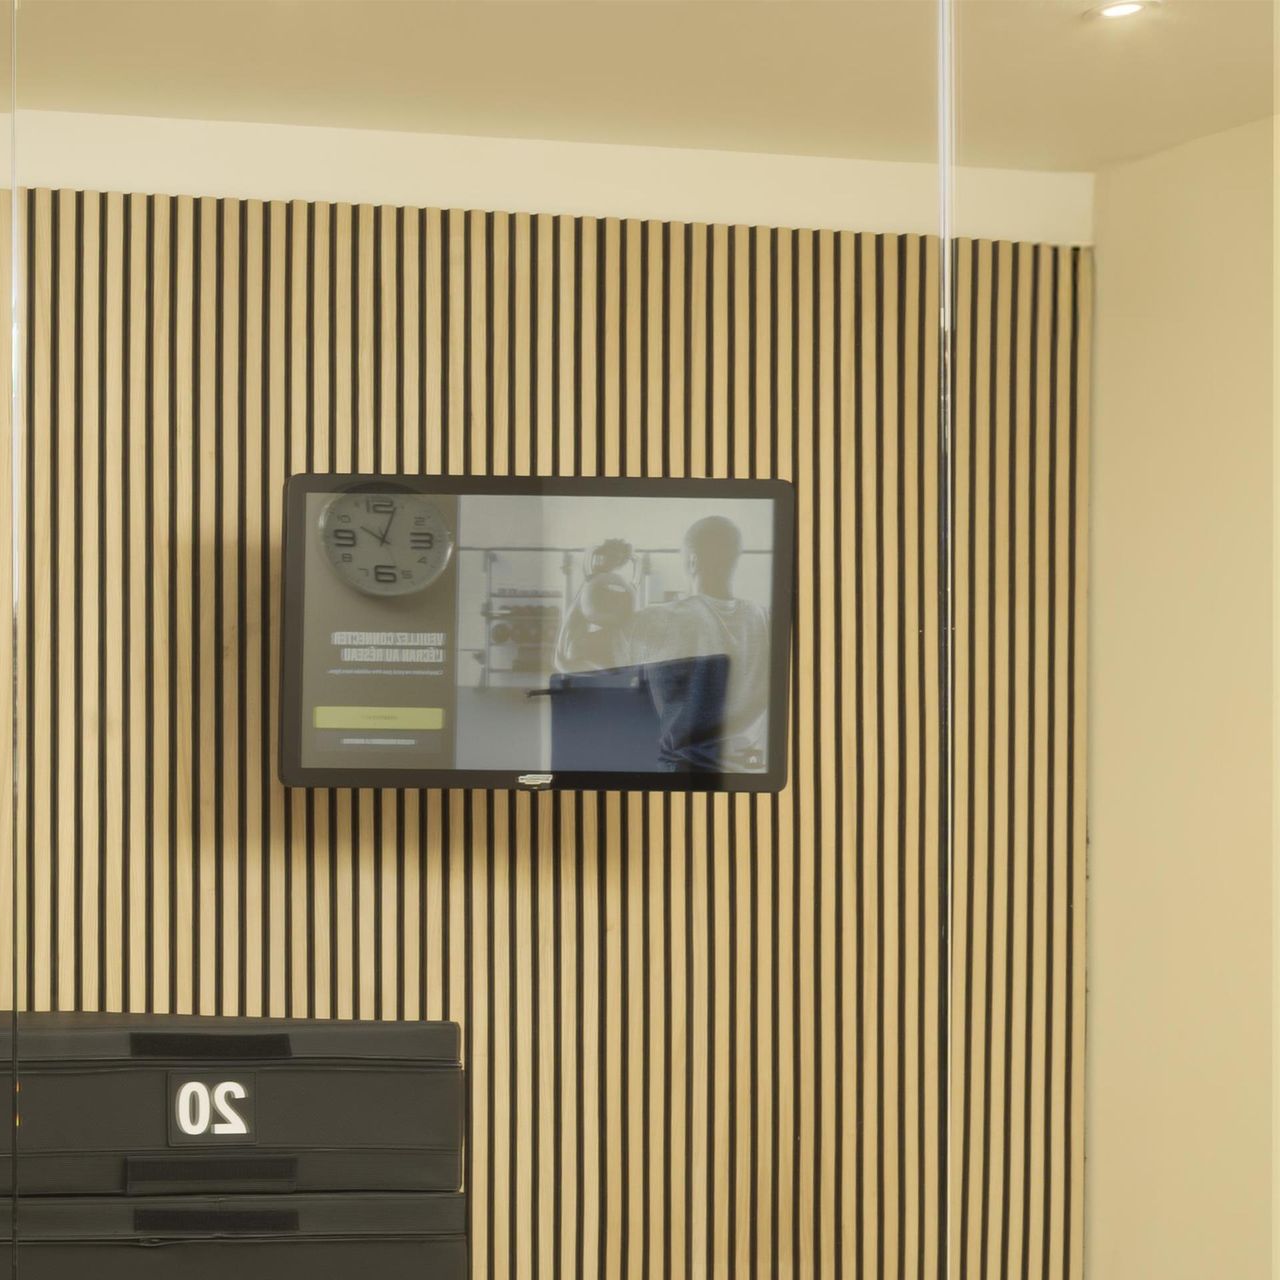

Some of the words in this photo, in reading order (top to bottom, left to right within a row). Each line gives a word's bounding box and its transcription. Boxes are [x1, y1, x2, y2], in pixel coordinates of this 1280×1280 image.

[333, 529, 356, 547] 9
[410, 532, 433, 549] 3
[374, 565, 397, 583] 6
